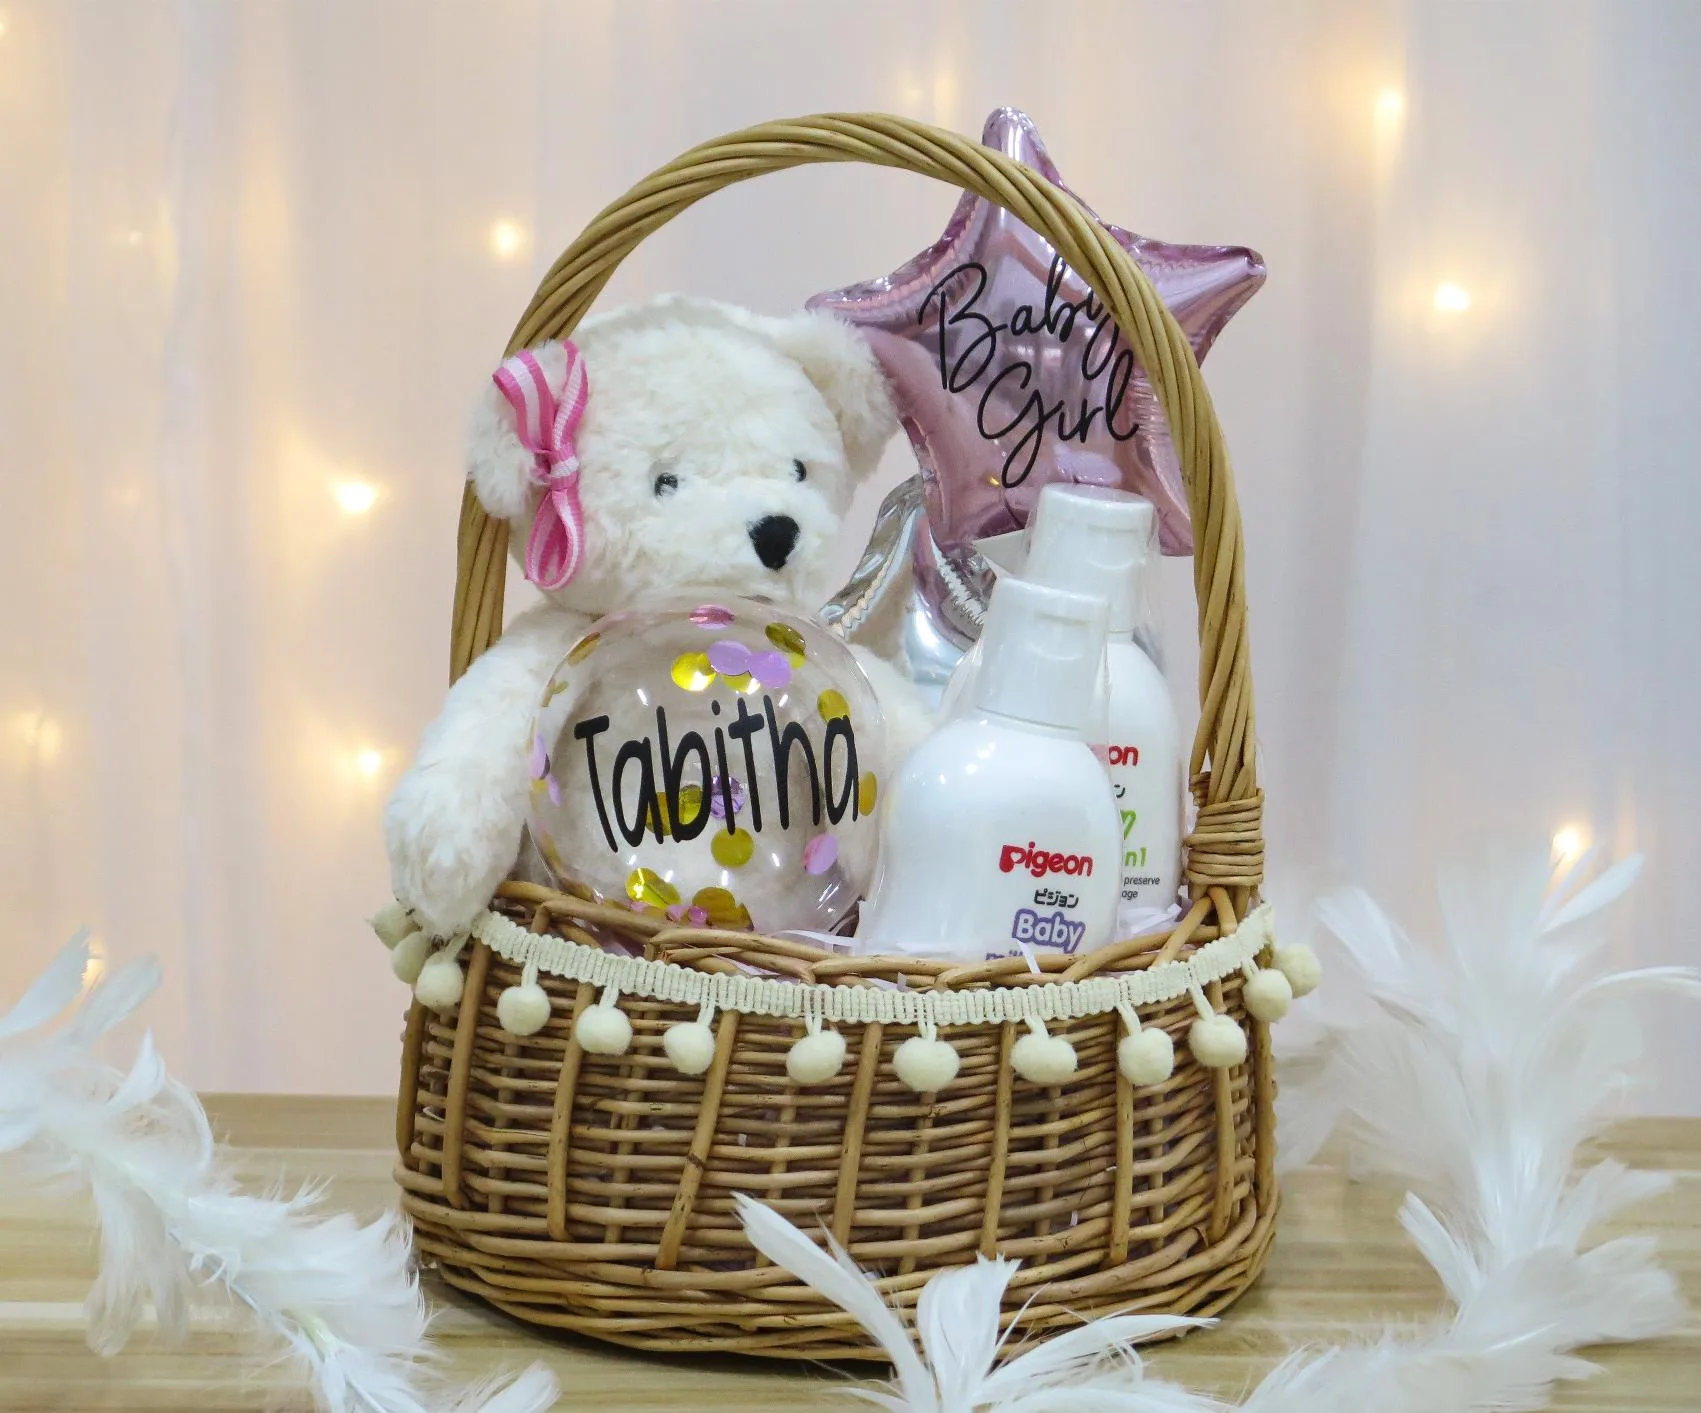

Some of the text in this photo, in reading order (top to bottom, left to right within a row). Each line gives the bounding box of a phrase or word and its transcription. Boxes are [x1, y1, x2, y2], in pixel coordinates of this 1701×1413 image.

[917, 255, 1120, 393] Baby
[976, 349, 1140, 488] Girl
[573, 695, 859, 853] Tabitha
[999, 841, 1094, 878] Pigeon
[1033, 888, 1079, 909] ピジョン
[1121, 889, 1139, 900] age
[1123, 876, 1161, 887] preserve
[1012, 908, 1086, 954] Baby
